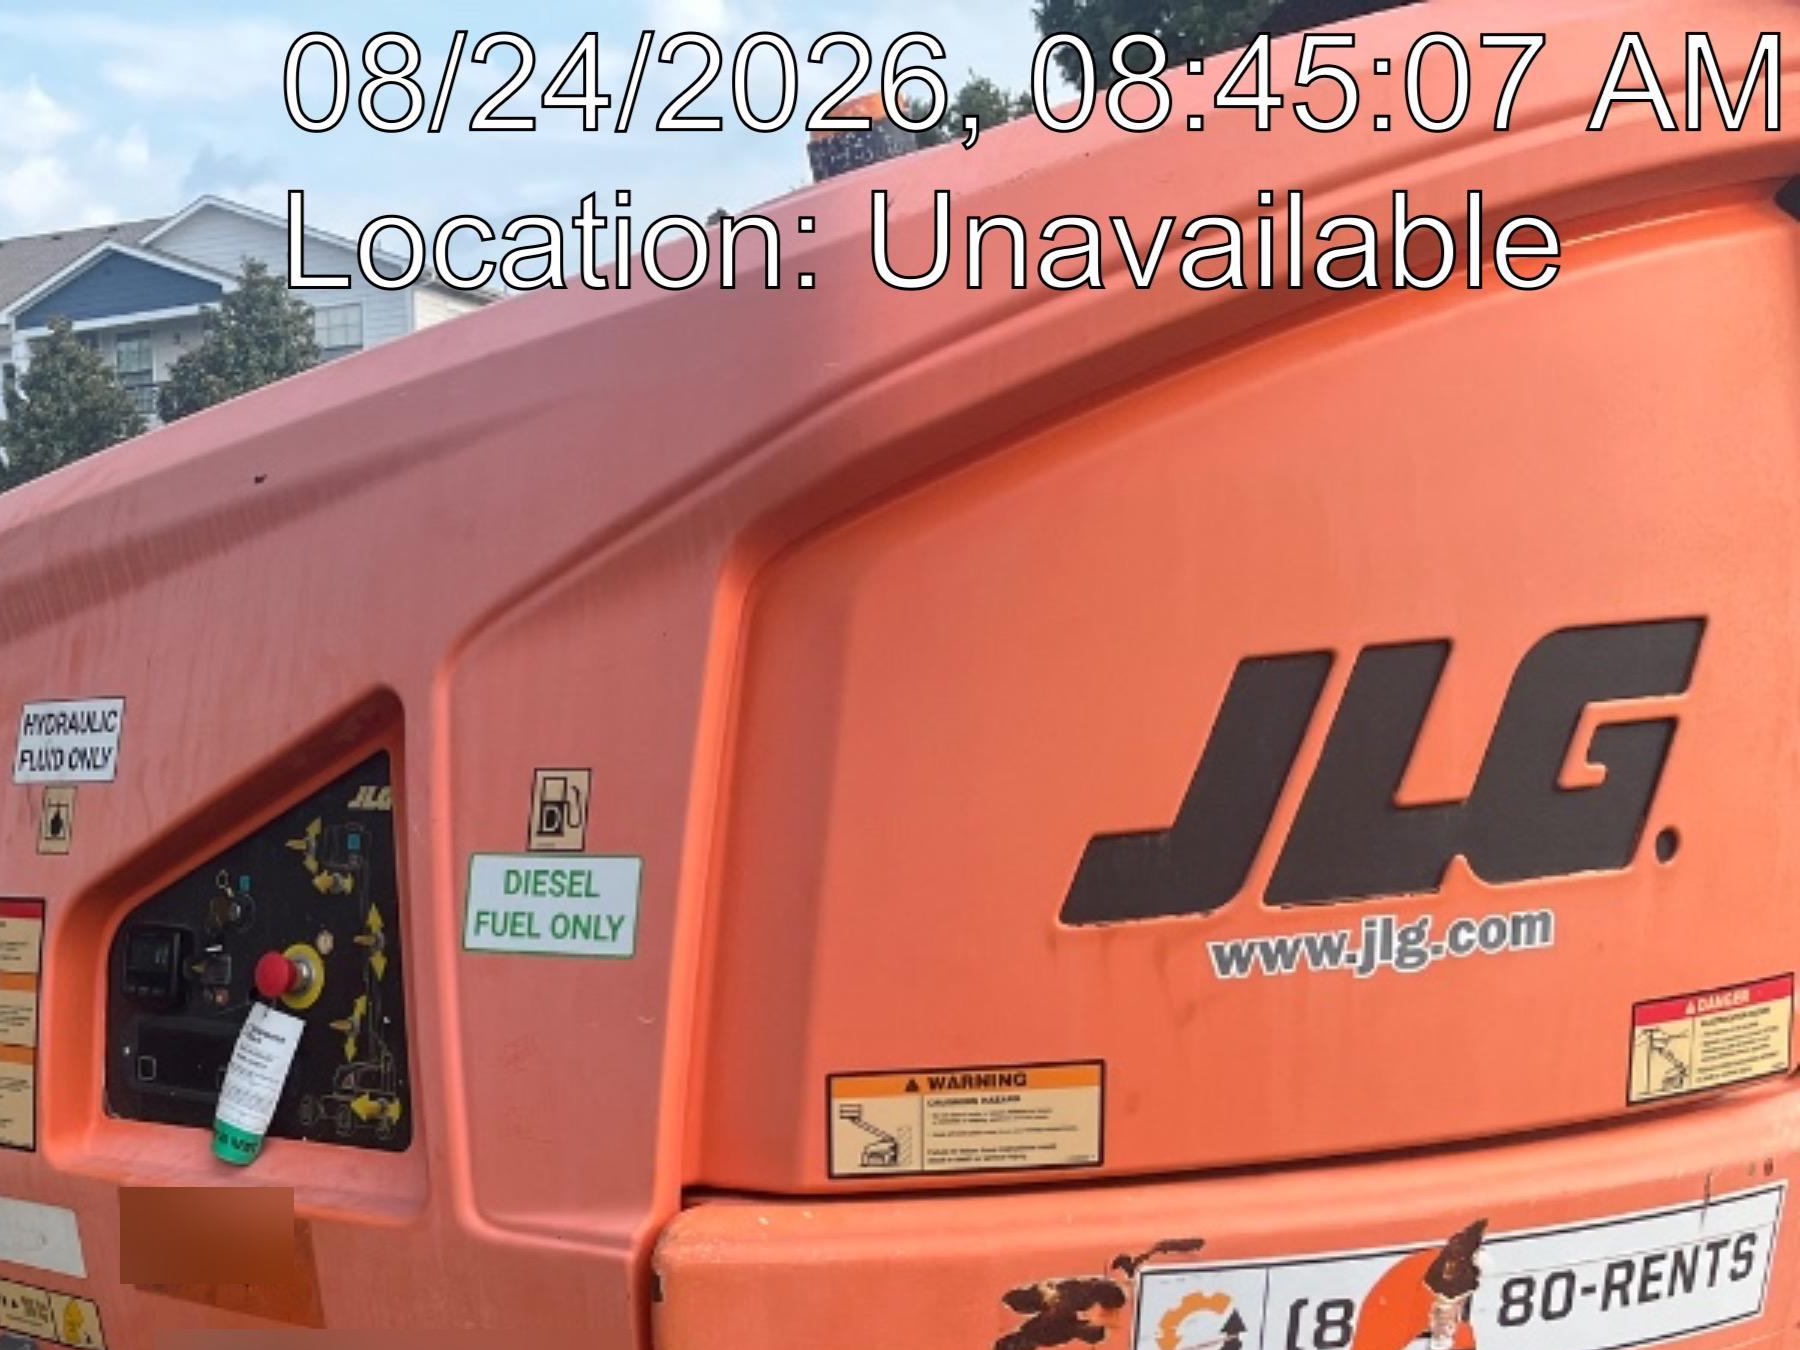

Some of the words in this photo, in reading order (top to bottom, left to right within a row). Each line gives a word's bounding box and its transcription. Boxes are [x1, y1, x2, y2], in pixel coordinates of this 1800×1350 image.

[23, 709, 119, 736] HYDRAULIC
[18, 746, 64, 772] FLUID
[67, 746, 114, 771] ONLY
[503, 868, 601, 898] DIESEL
[473, 910, 541, 939] FUEL
[550, 911, 626, 943] ONLY
[1208, 908, 1555, 979] www.jlg.com
[927, 1071, 1028, 1091] WARNING
[1496, 1231, 1758, 1328] 80-RENTS
